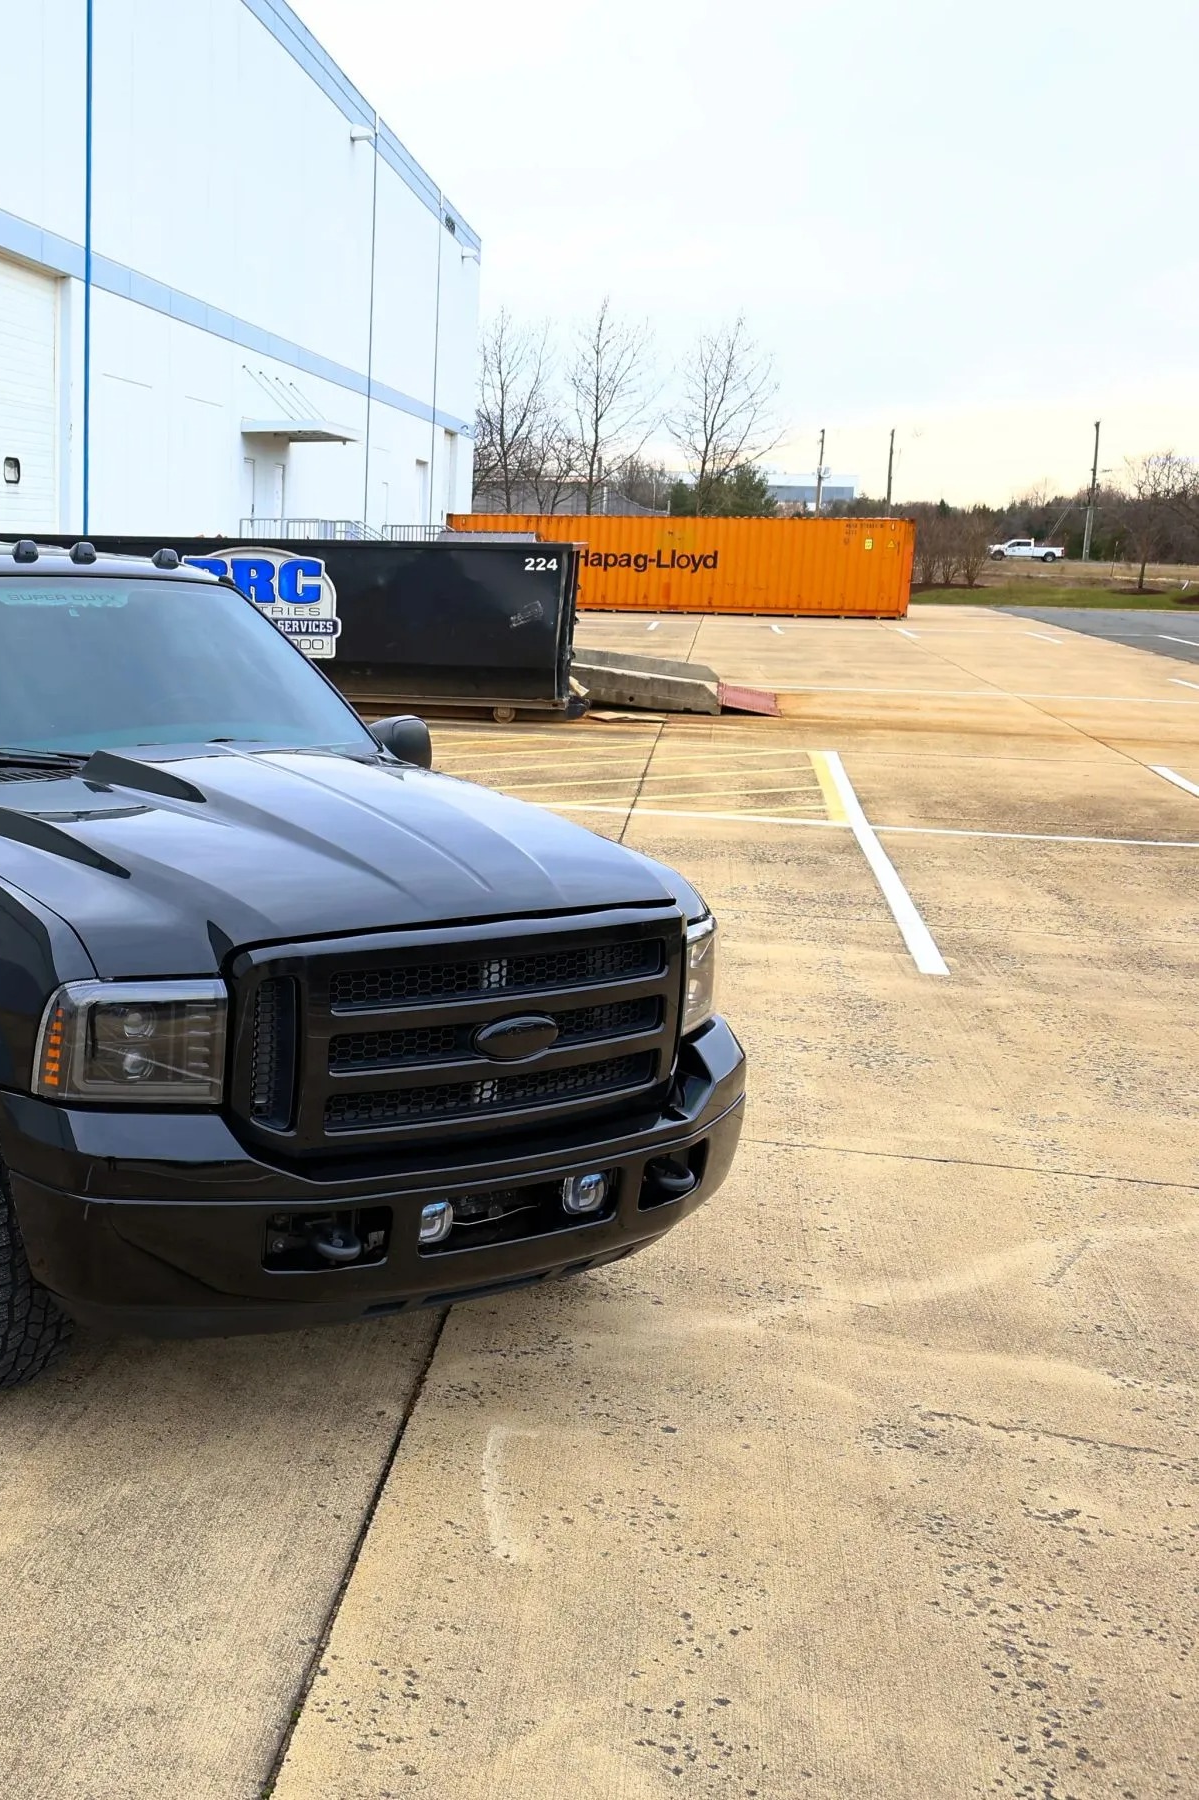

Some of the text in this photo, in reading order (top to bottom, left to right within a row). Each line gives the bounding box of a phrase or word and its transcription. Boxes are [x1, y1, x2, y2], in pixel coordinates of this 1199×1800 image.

[524, 557, 558, 571] 224
[578, 549, 718, 572] Hapag-Lloyd
[278, 621, 333, 632] SERVICES
